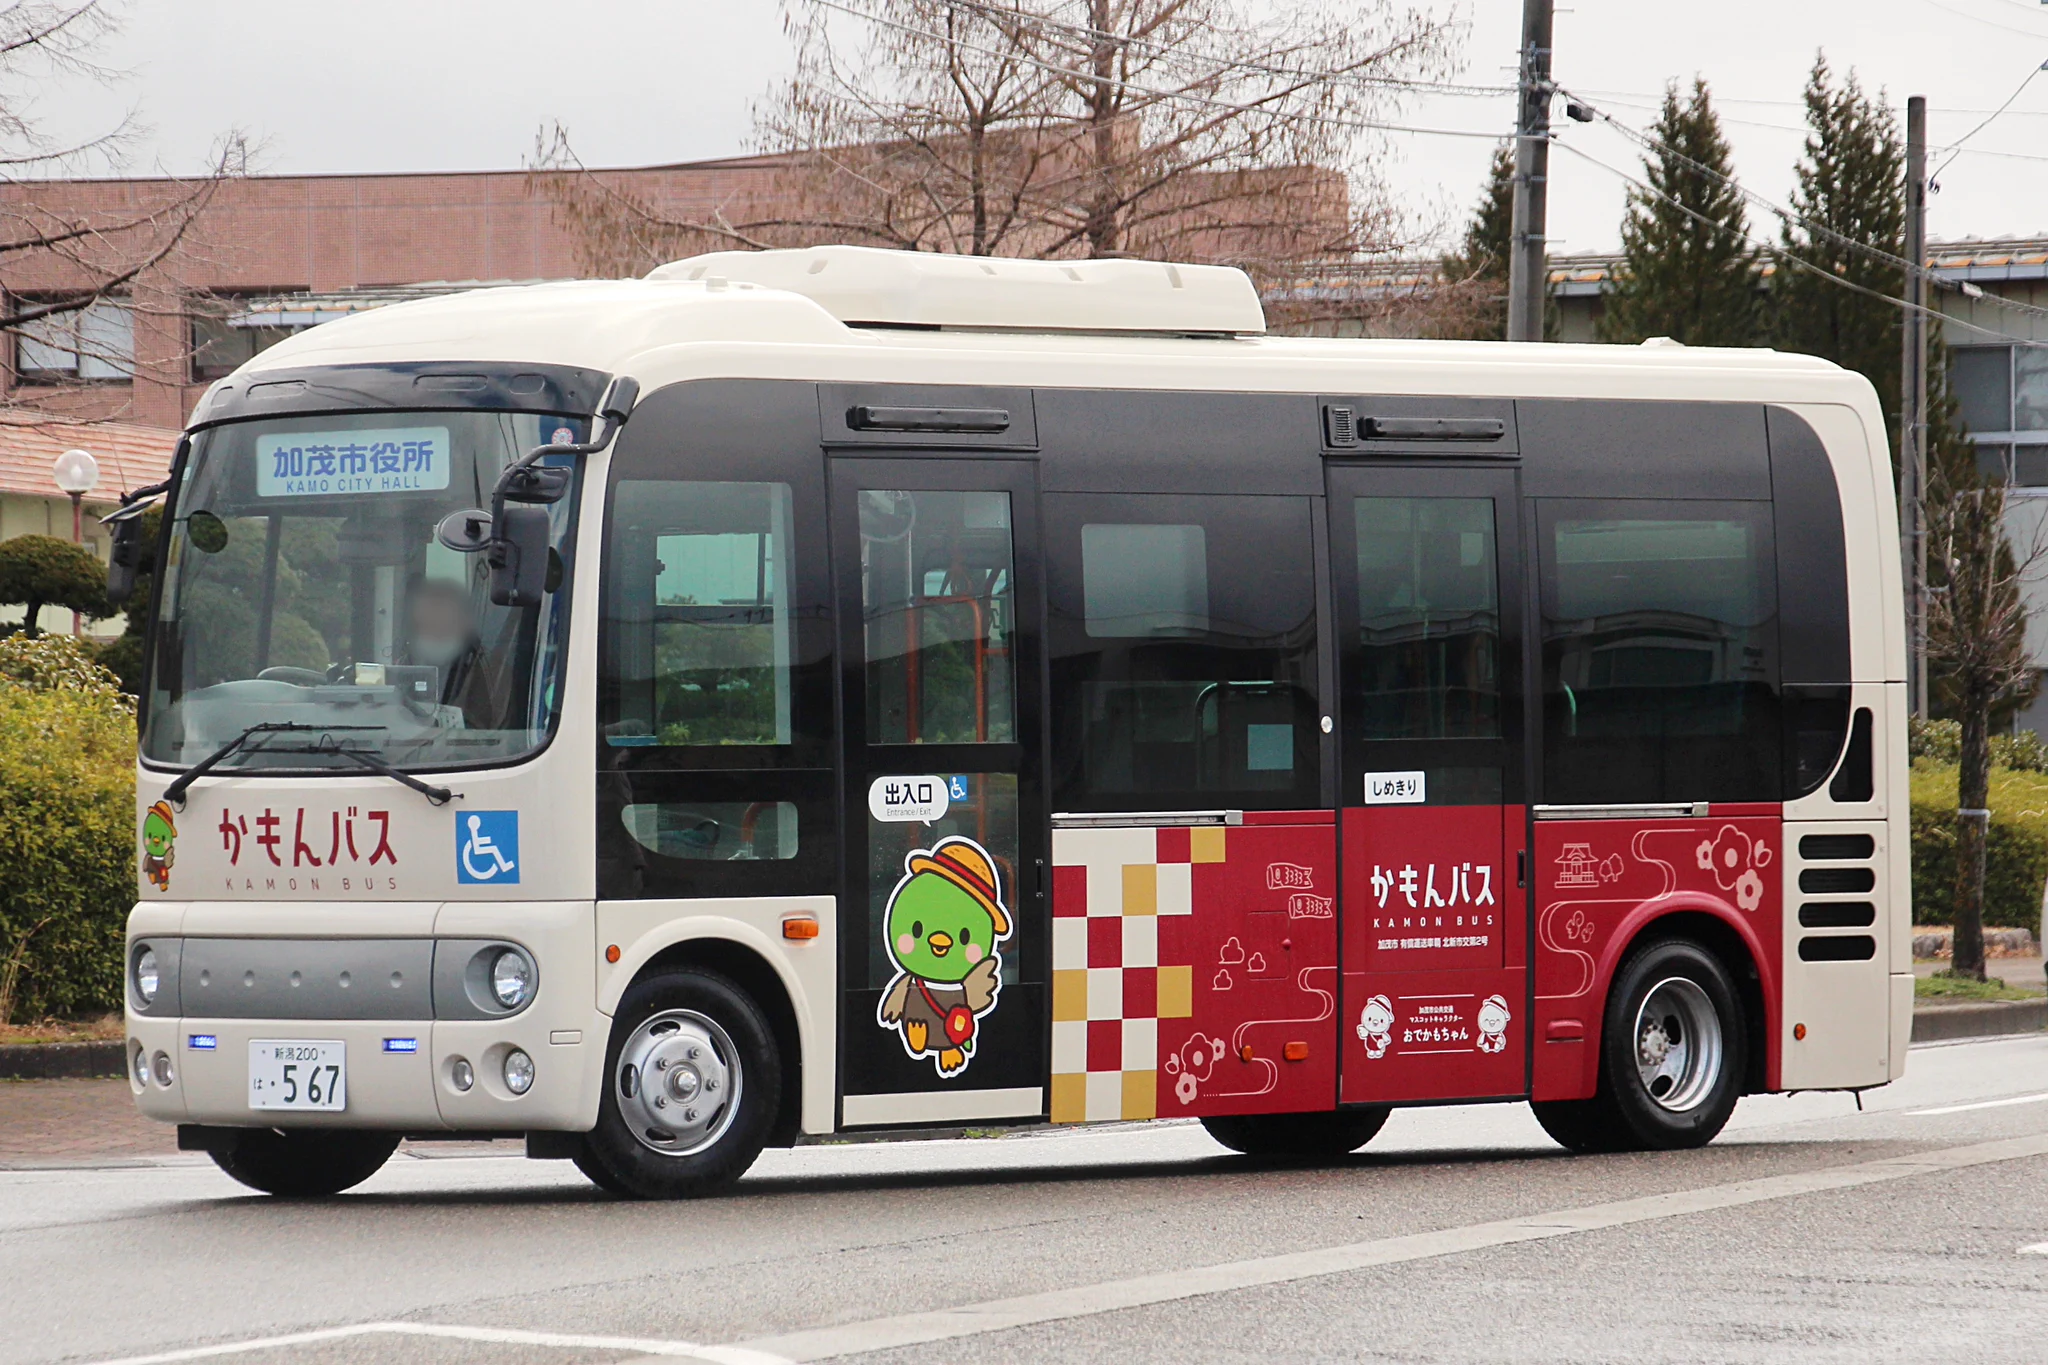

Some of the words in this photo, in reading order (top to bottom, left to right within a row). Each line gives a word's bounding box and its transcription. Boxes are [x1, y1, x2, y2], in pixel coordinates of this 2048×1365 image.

[273, 440, 434, 478] 加茂市役所
[286, 479, 329, 494] KAMO
[338, 477, 373, 491] CITY
[381, 475, 421, 489] HALL
[885, 783, 932, 805] 出入口
[1373, 779, 1417, 796] しめきり
[218, 806, 398, 867] かもんバス
[226, 878, 320, 891] KAMON
[343, 877, 397, 891] BUS
[1370, 862, 1495, 908] かもんバス
[1374, 916, 1442, 928] KAMON
[1457, 915, 1493, 926] BUS
[1409, 1015, 1463, 1023] マスコットキャラクター
[1403, 1027, 1469, 1042] おでかもちゃん
[253, 1078, 262, 1090] は
